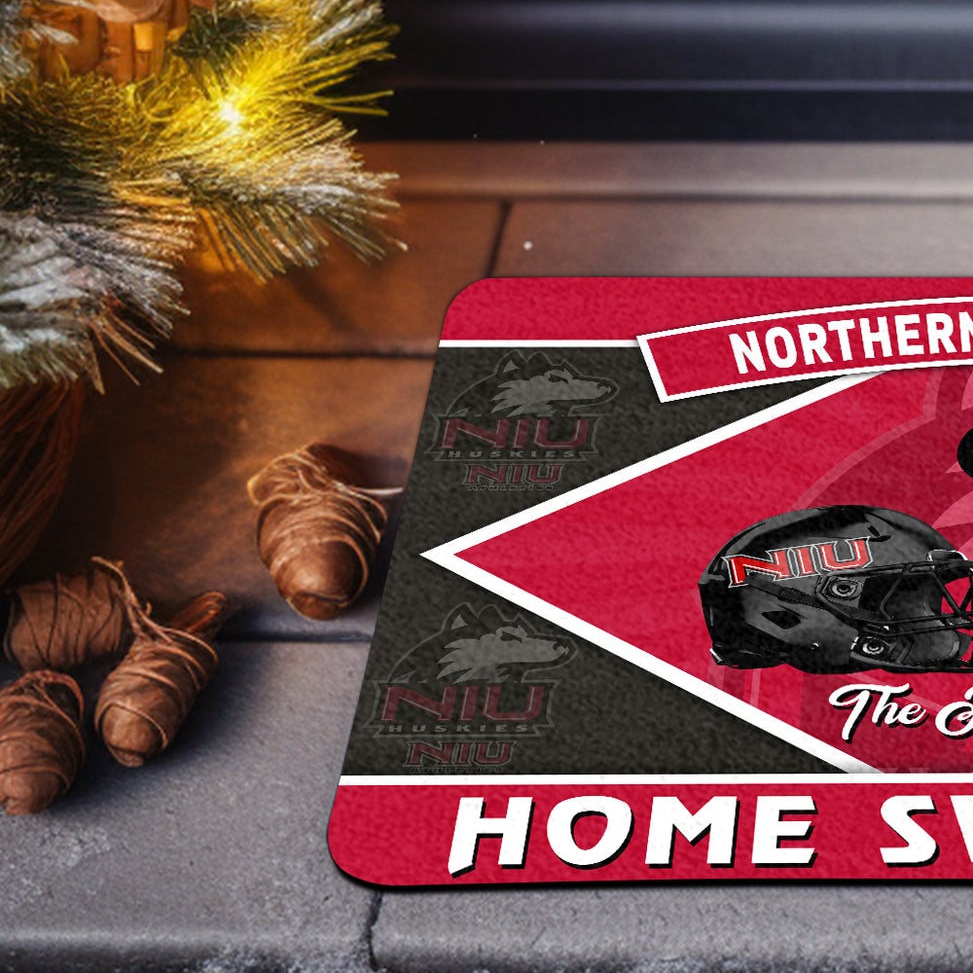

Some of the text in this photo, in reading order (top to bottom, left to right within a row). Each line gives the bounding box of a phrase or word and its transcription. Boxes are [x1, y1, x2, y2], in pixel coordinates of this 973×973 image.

[438, 417, 591, 449] NIU
[447, 450, 576, 458] HUSKIES
[463, 463, 564, 485] NIU
[722, 536, 873, 589] NIU
[380, 685, 545, 723] NIU
[828, 682, 926, 743] The
[388, 724, 529, 733] HUSKIES
[402, 740, 516, 767] NIU
[447, 794, 818, 877] HOME
